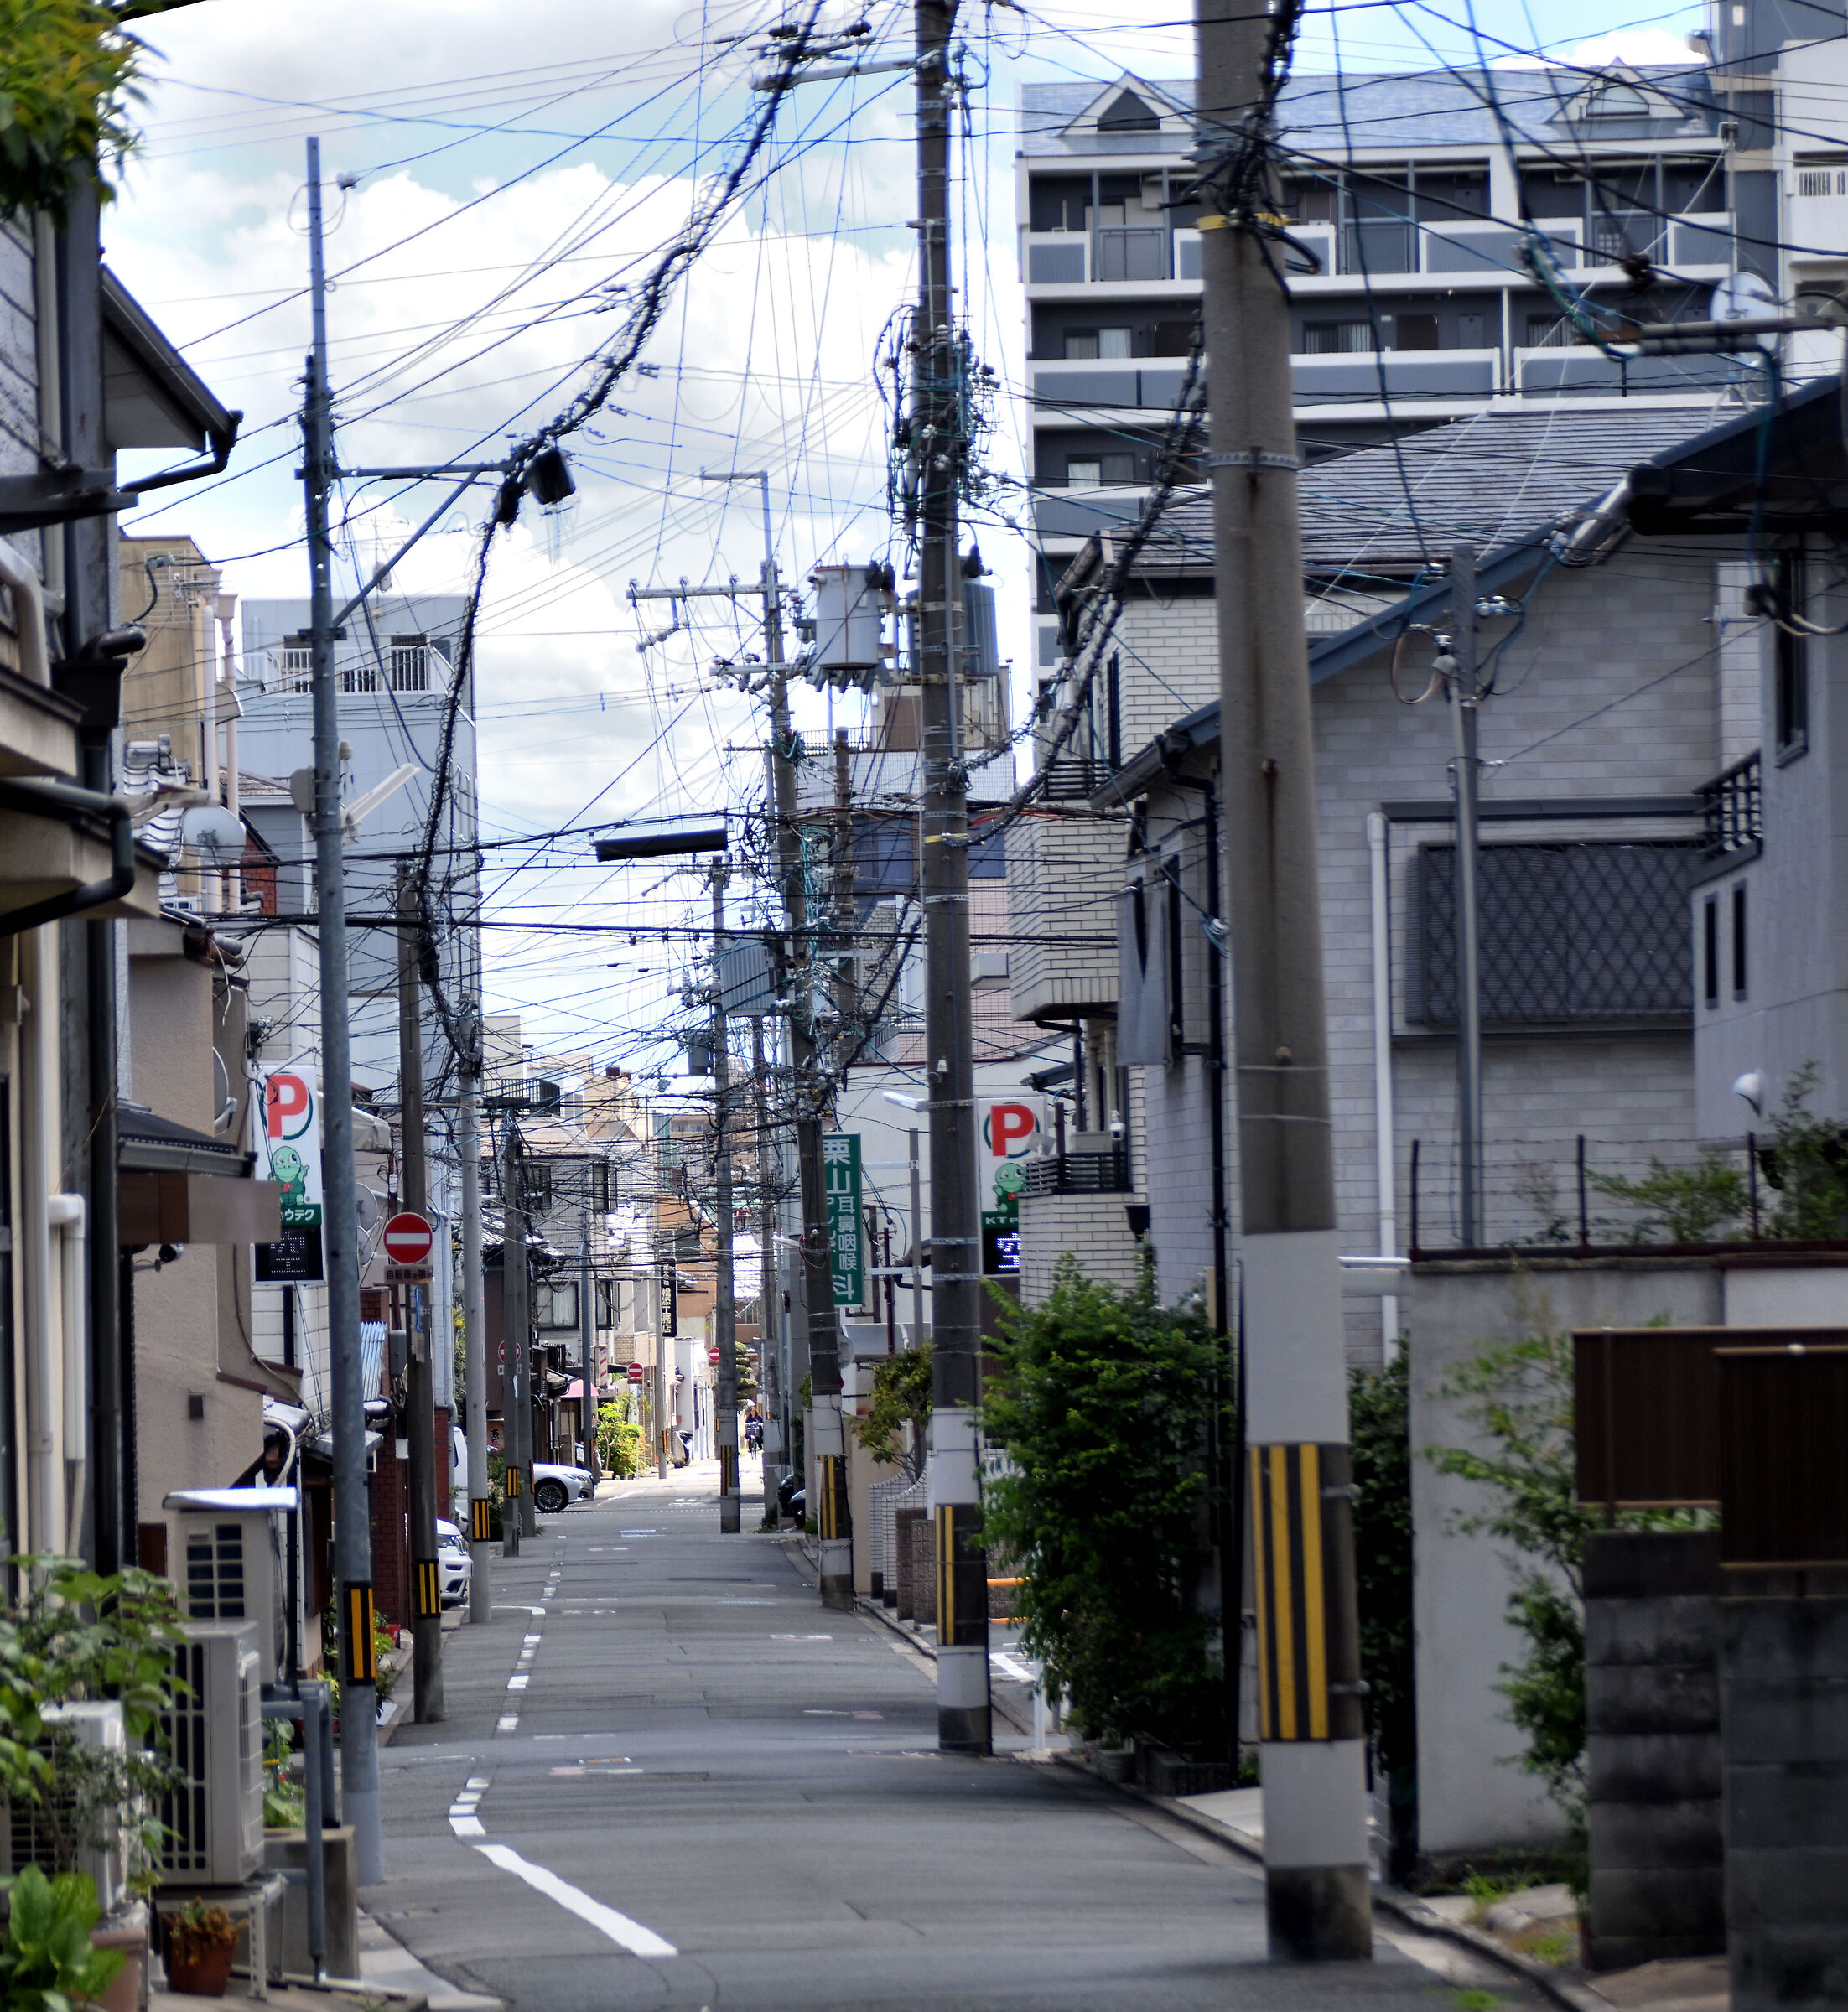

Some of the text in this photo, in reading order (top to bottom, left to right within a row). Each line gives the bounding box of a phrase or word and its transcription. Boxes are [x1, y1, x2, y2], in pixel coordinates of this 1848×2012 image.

[267, 1074, 309, 1138] P
[991, 1104, 1035, 1157] P
[280, 1209, 314, 1221] ウテク
